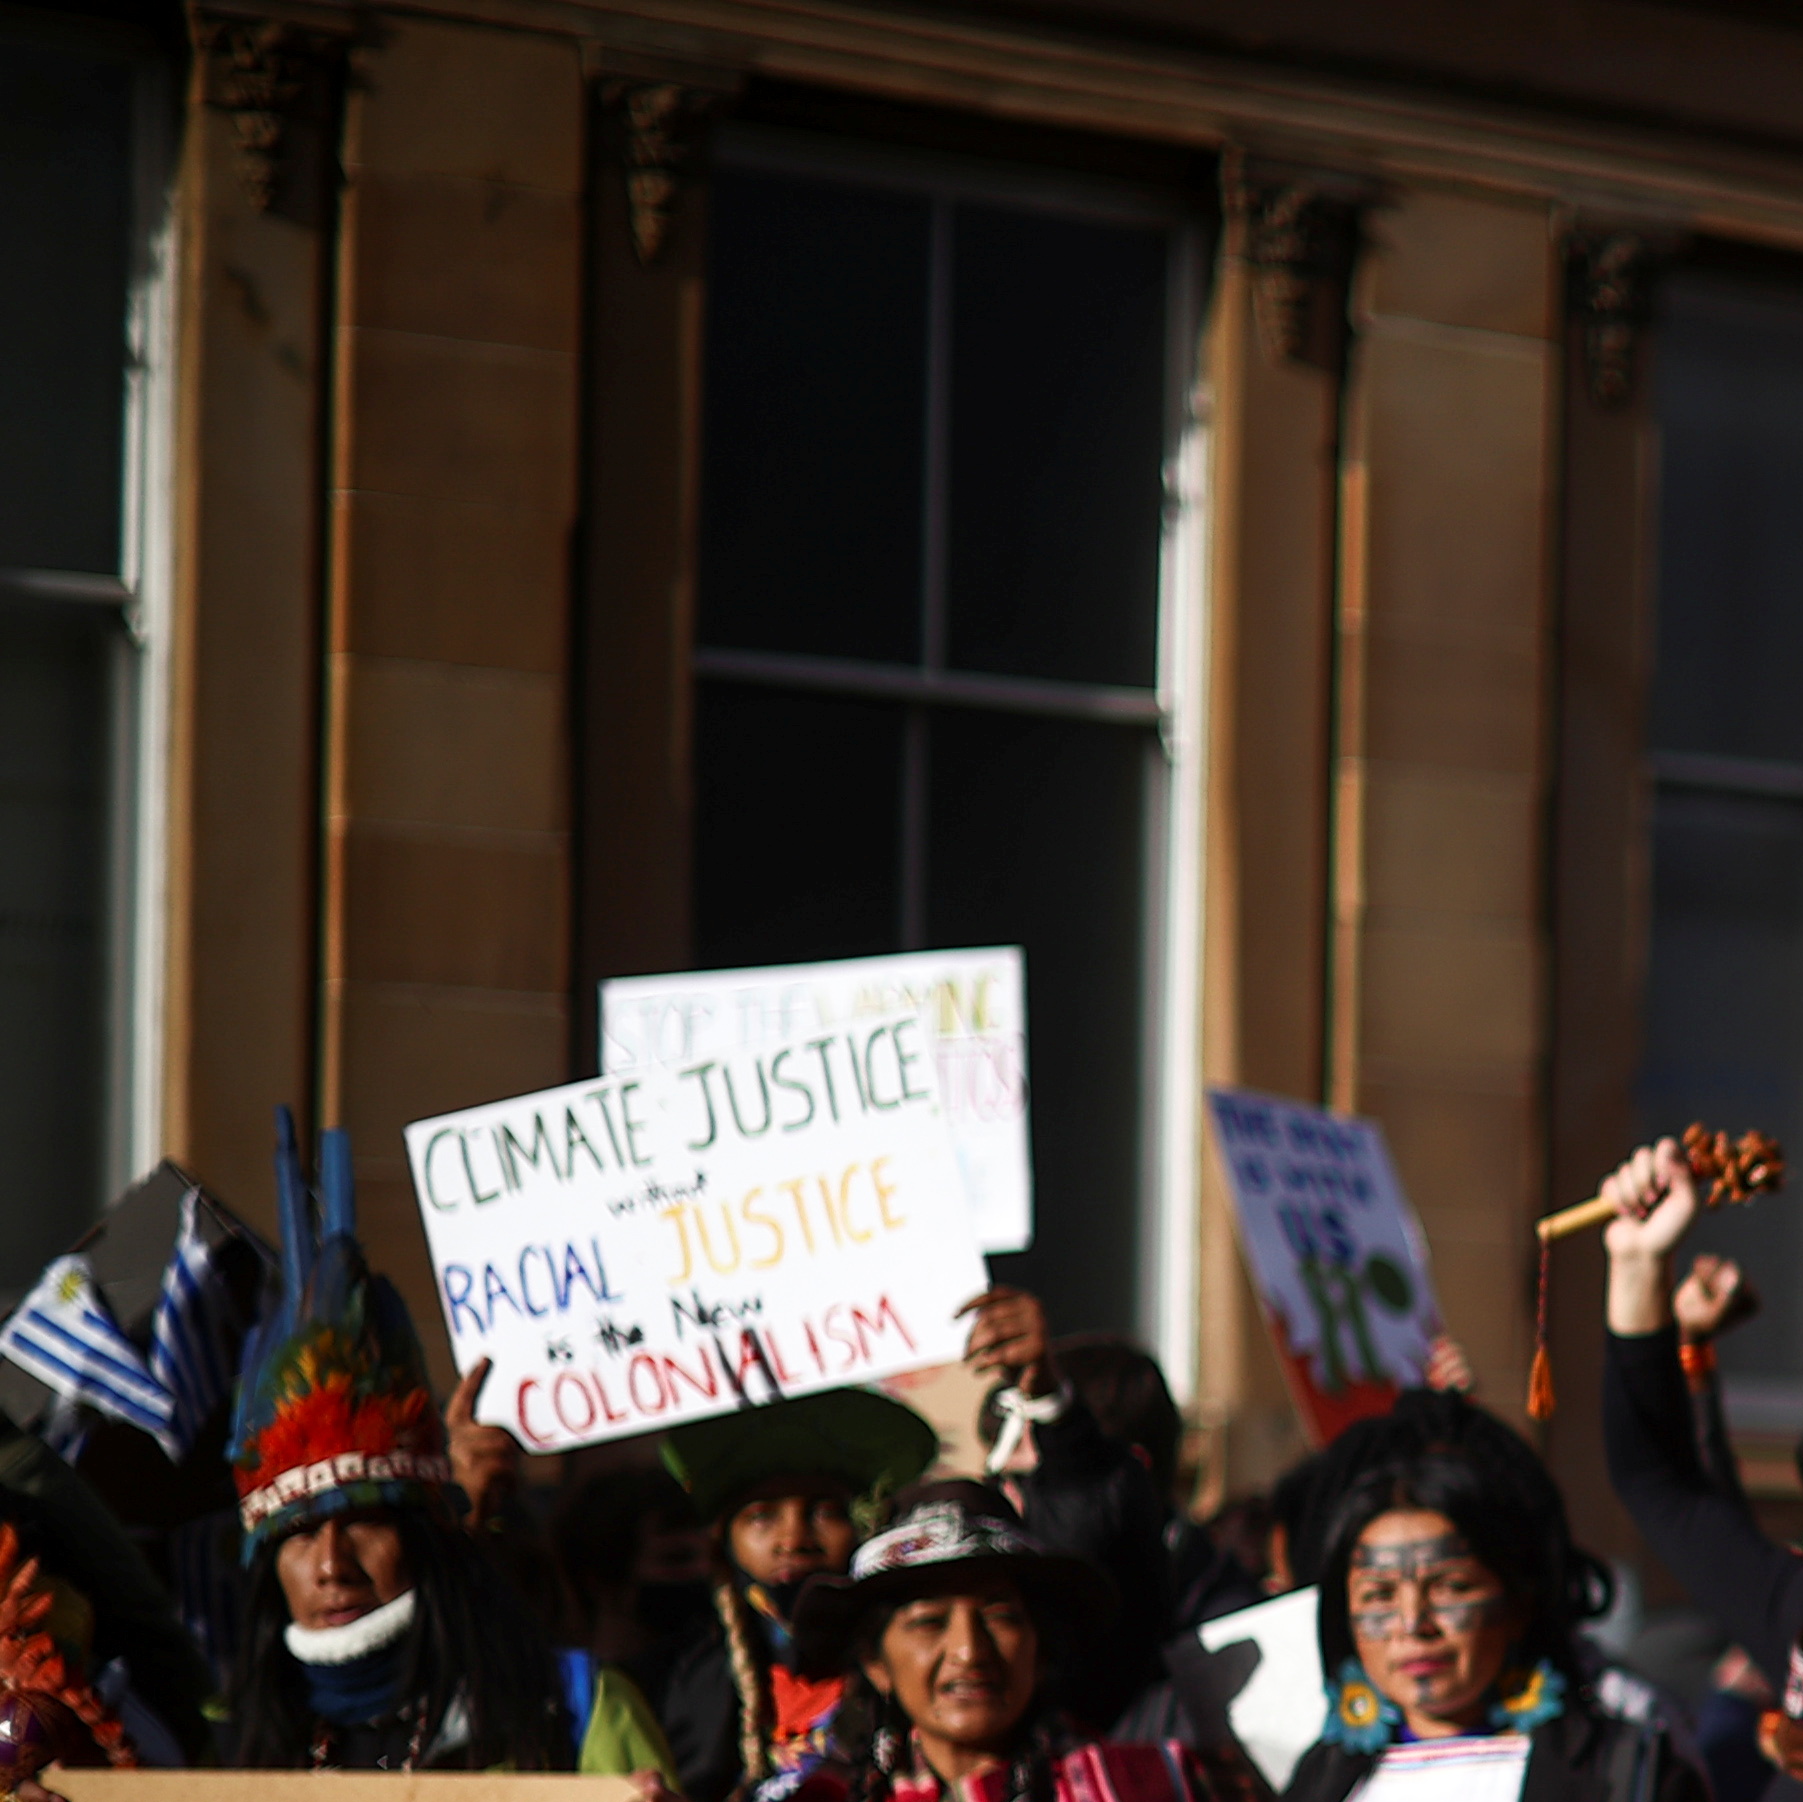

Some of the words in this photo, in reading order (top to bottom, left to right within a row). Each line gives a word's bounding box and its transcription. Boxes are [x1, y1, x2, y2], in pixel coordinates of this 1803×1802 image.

[424, 1081, 653, 1212] CLIMATE
[681, 1019, 929, 1151] JUSTICE
[444, 1237, 625, 1335] RACIAL
[661, 1156, 906, 1285] JUSTICE
[671, 1287, 763, 1338] New
[516, 1293, 917, 1447] COLONALISM
